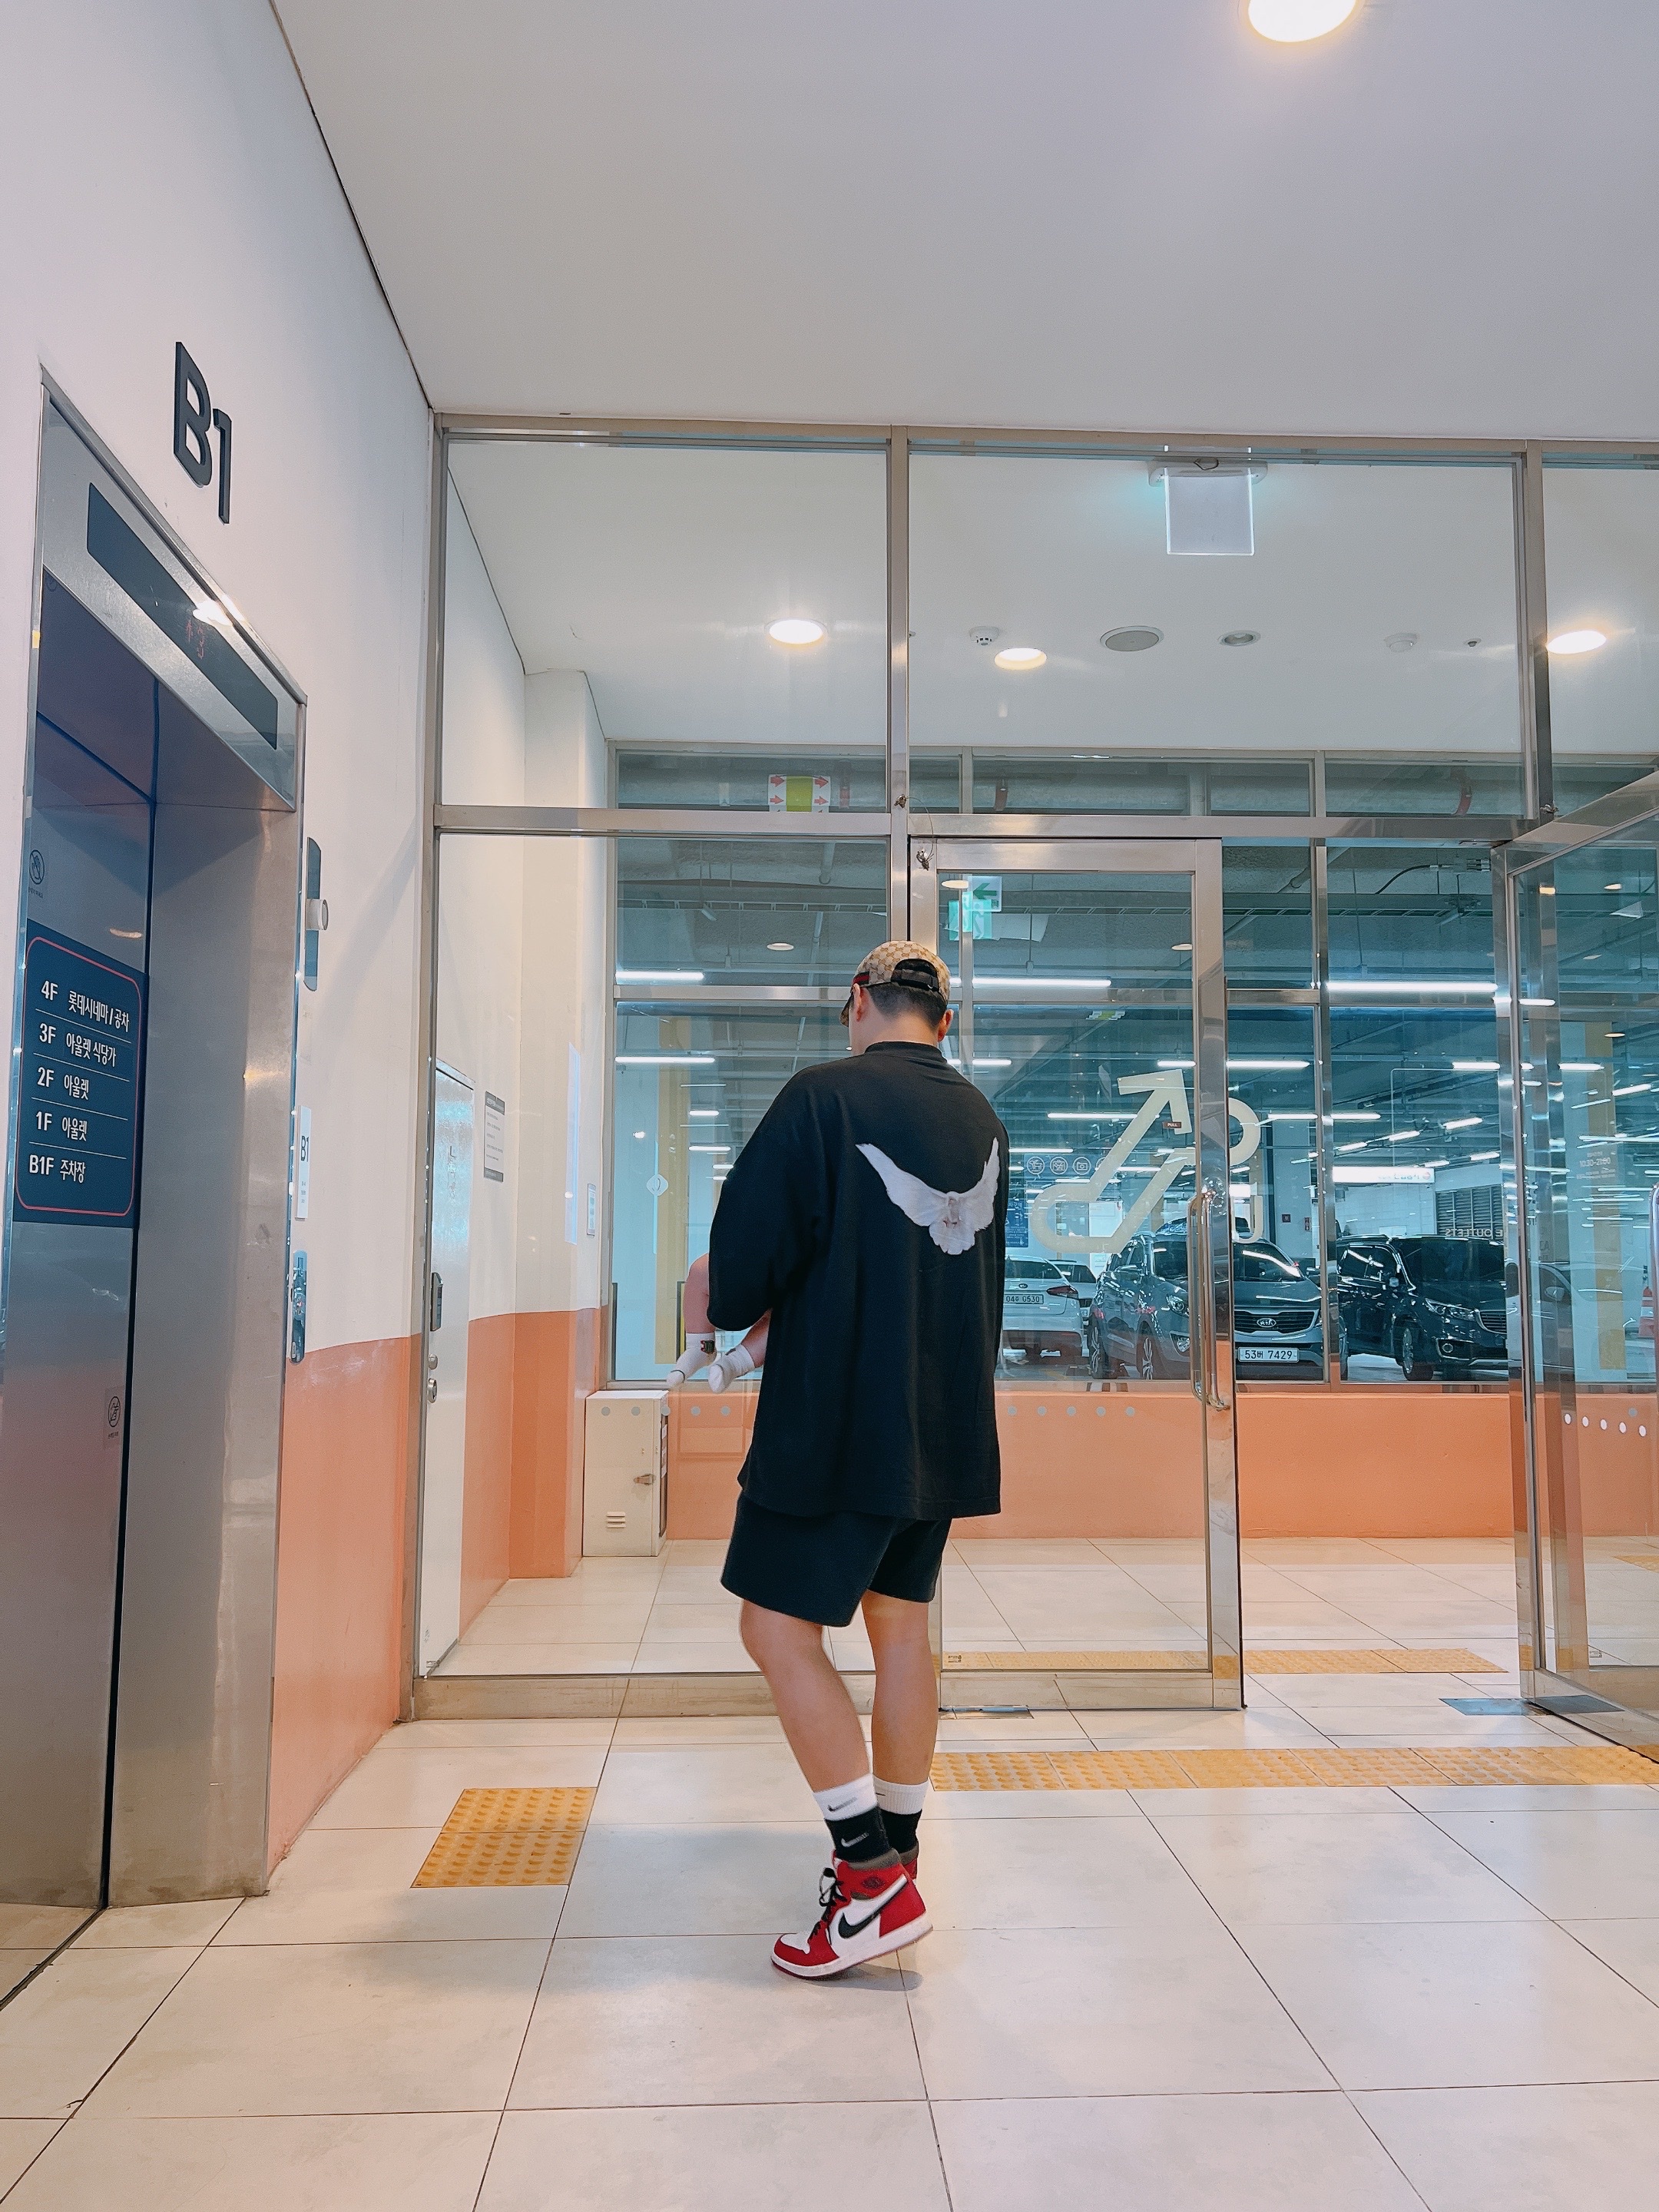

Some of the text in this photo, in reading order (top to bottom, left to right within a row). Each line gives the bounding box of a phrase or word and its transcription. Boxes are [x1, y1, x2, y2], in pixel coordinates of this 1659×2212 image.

[174, 341, 232, 525] B1
[41, 980, 58, 1001] 4F
[39, 1023, 117, 1067] 3F 아울렛 식당가
[37, 1067, 89, 1101] 2F 아울렛
[35, 1111, 88, 1142] 1F 아울렛
[300, 1135, 310, 1163] B1
[28, 1154, 86, 1184] B1F 주차장
[1267, 1349, 1293, 1360] 7429
